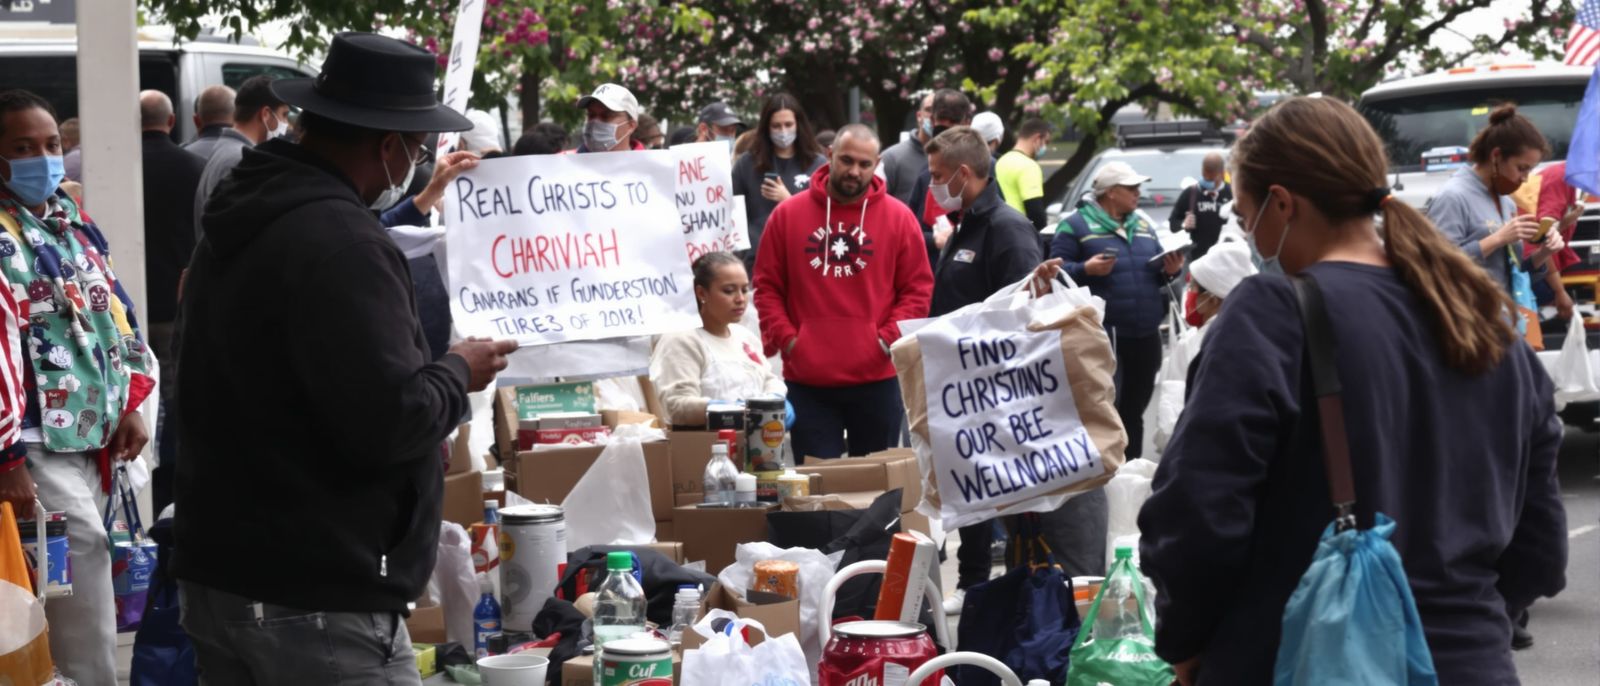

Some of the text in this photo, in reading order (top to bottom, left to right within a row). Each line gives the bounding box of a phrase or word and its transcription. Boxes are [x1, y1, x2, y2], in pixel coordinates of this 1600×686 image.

[456, 174, 650, 223] REAL CHRISTS TO
[705, 184, 728, 204] OR
[545, 285, 562, 305] IF
[957, 336, 1017, 370] FIND
[956, 406, 1054, 460] OUR BEE
